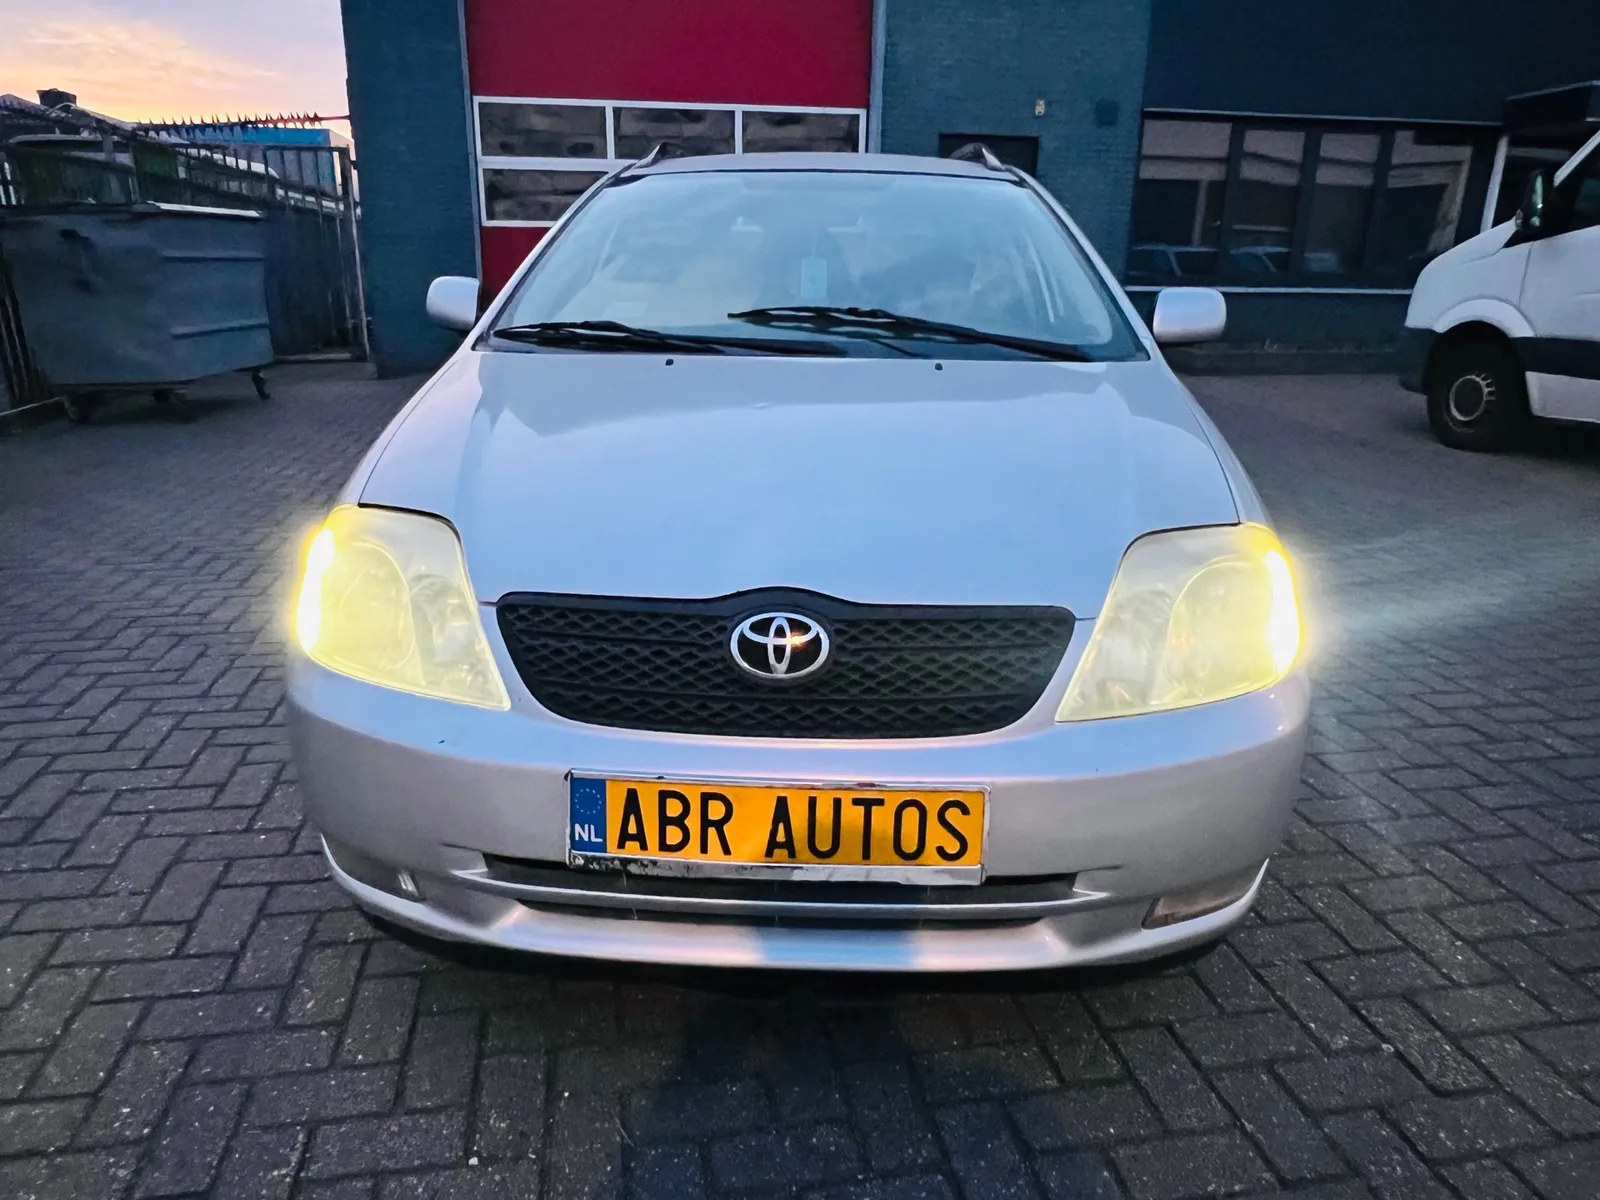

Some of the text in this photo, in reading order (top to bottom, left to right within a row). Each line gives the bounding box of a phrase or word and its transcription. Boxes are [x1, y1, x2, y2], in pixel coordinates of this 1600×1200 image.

[574, 823, 603, 843] NL
[617, 787, 971, 862] ABR AUTOS
